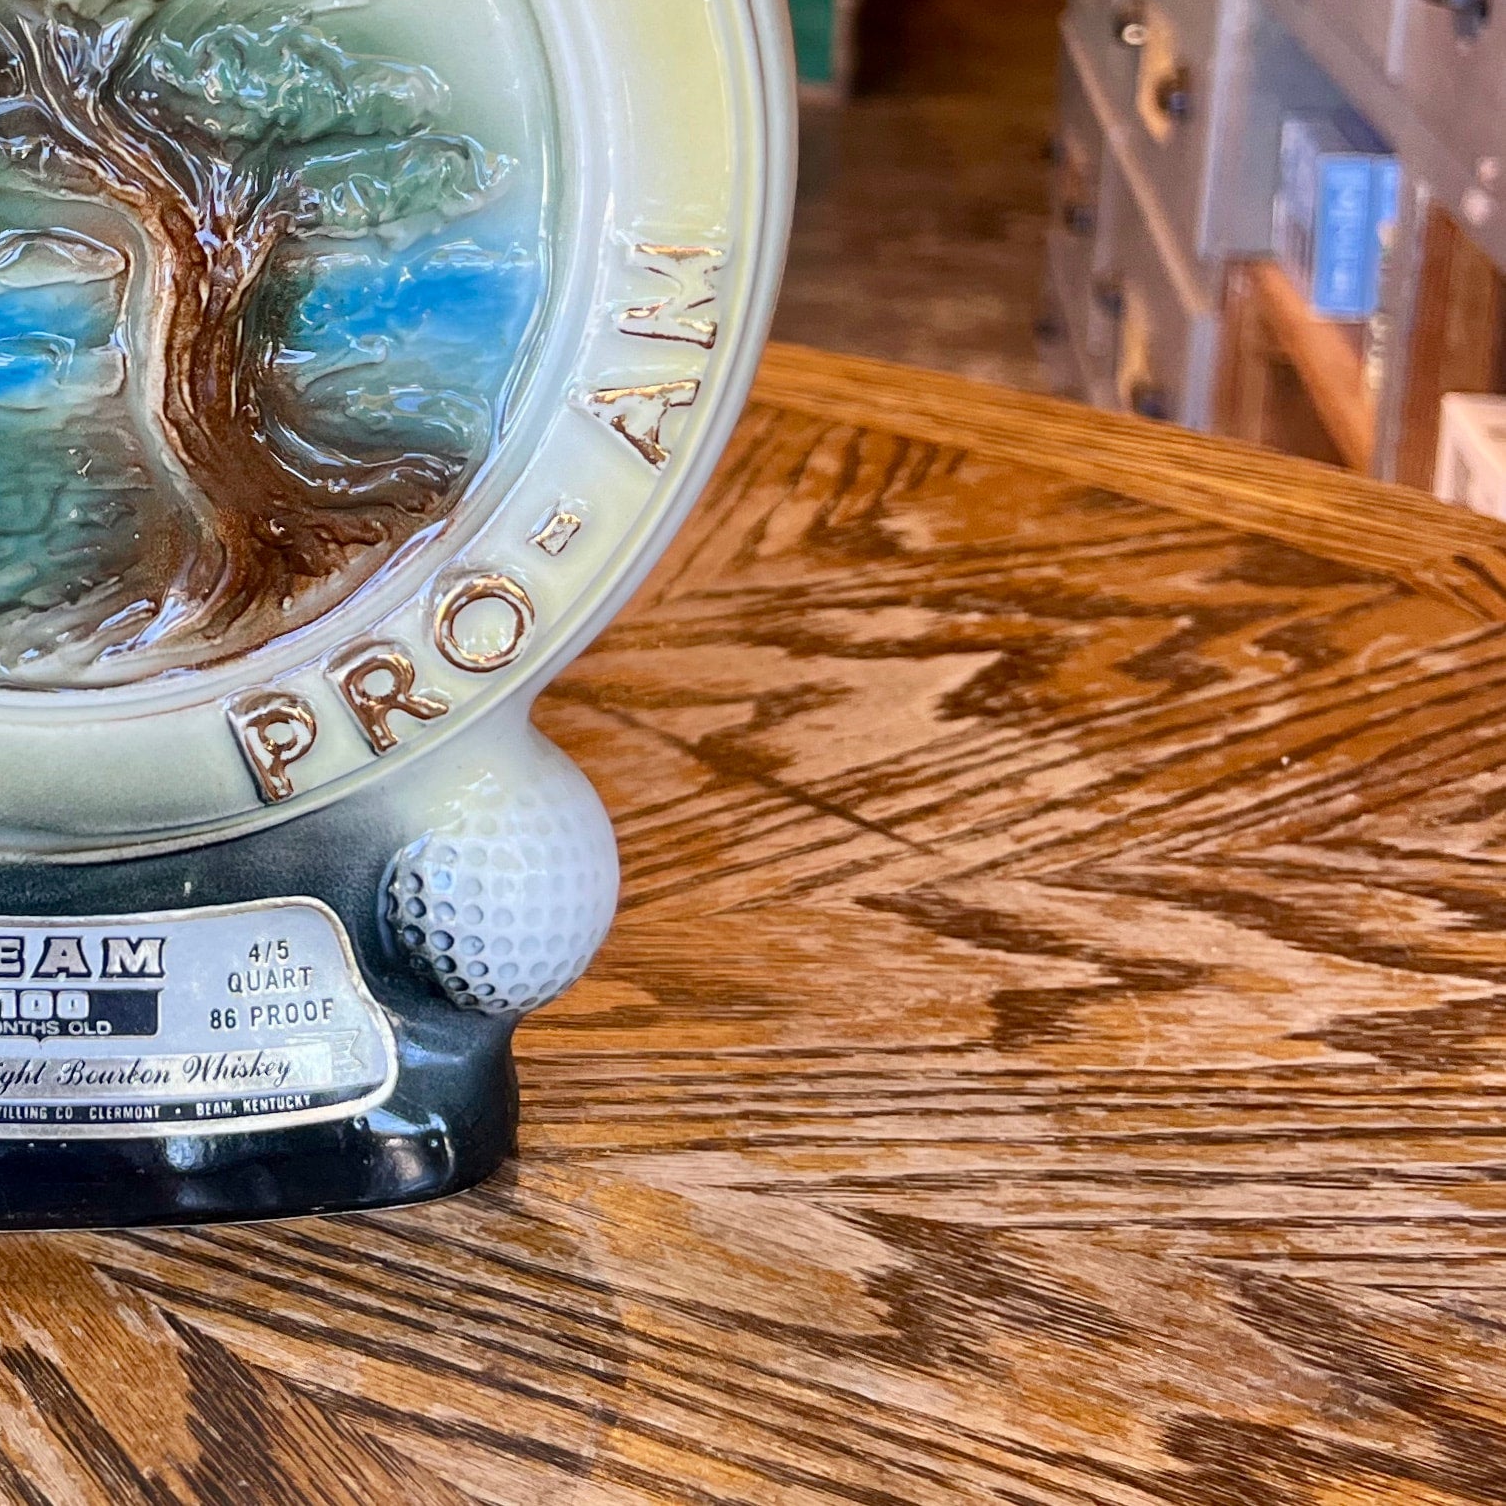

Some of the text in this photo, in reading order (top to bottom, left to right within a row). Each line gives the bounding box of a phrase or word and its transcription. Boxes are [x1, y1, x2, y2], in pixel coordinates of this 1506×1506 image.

[248, 939, 290, 963] 4/5
[227, 965, 314, 993] QUART
[67, 1019, 113, 1036] OLD
[209, 999, 334, 1030] 86 PROOF
[56, 1057, 171, 1086] Bourbon
[182, 1050, 292, 1088] Whiskey
[89, 1105, 161, 1121] CLERMONT
[242, 1093, 312, 1113] KENTUCKY
